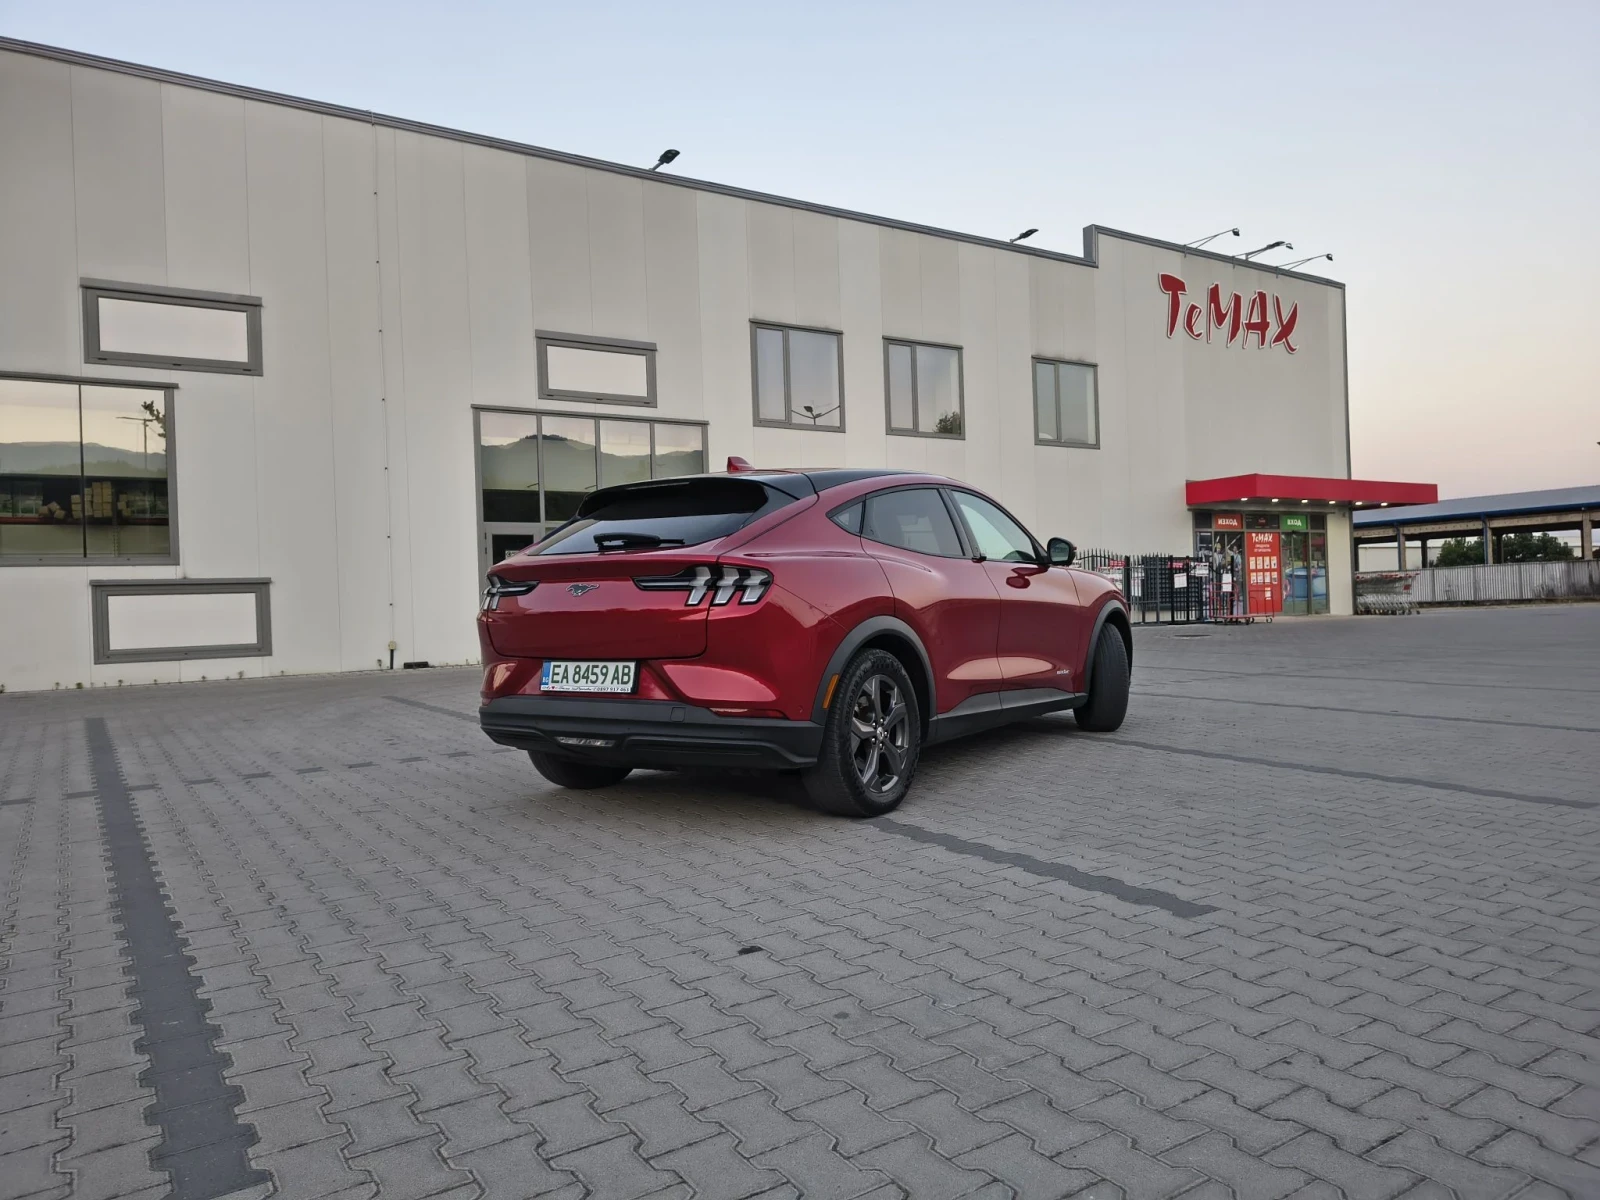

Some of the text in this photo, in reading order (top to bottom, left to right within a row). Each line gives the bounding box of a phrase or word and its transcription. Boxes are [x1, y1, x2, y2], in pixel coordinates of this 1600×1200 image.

[1158, 272, 1300, 354] TeMAX
[1217, 518, 1238, 526] ИЗХОД
[1251, 532, 1273, 543] TeMAX
[551, 664, 631, 685] EA 8459 AB
